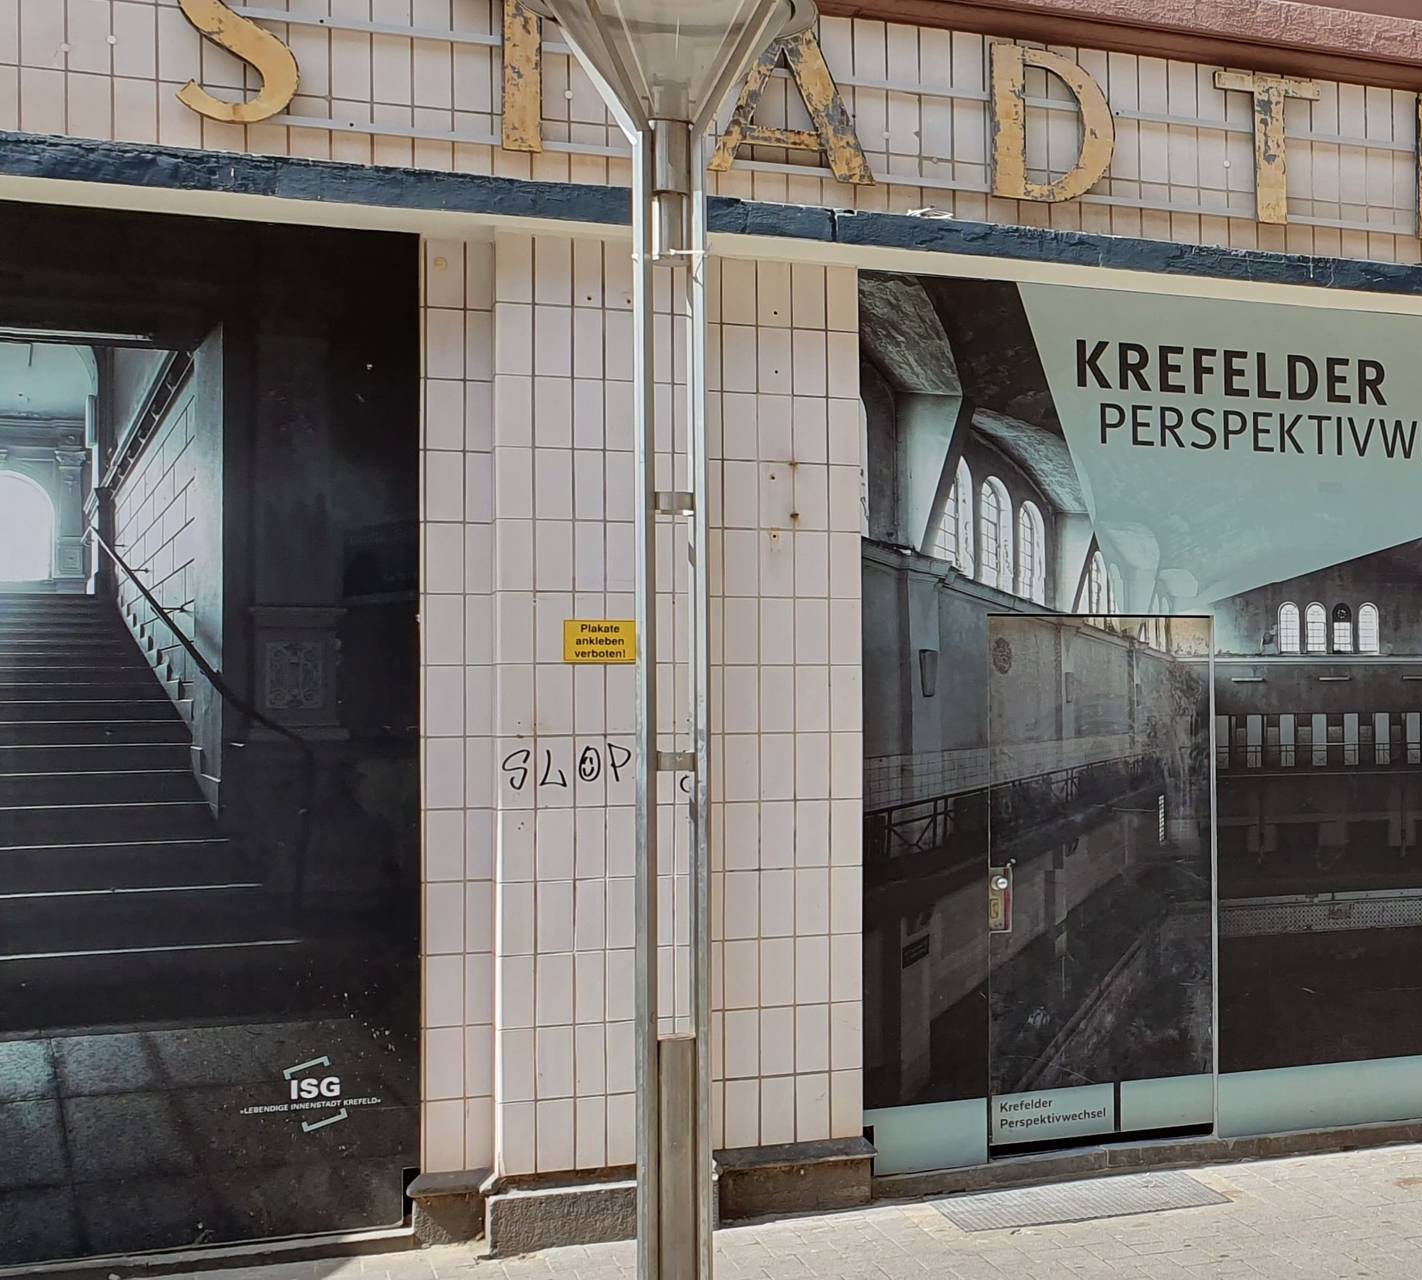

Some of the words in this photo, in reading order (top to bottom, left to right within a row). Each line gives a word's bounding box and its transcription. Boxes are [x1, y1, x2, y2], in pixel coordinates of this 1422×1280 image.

[1075, 338, 1388, 406] KREFELDER
[580, 624, 620, 633] Plakate
[575, 636, 625, 646] ankleben
[574, 648, 626, 658] verboten!
[502, 742, 632, 790] SLOP
[290, 1077, 341, 1100] ISG
[290, 1100, 341, 1111] INNENSTADT
[999, 1098, 1053, 1113] Krefelder
[999, 1107, 1107, 1129] Perspektivwechsel
